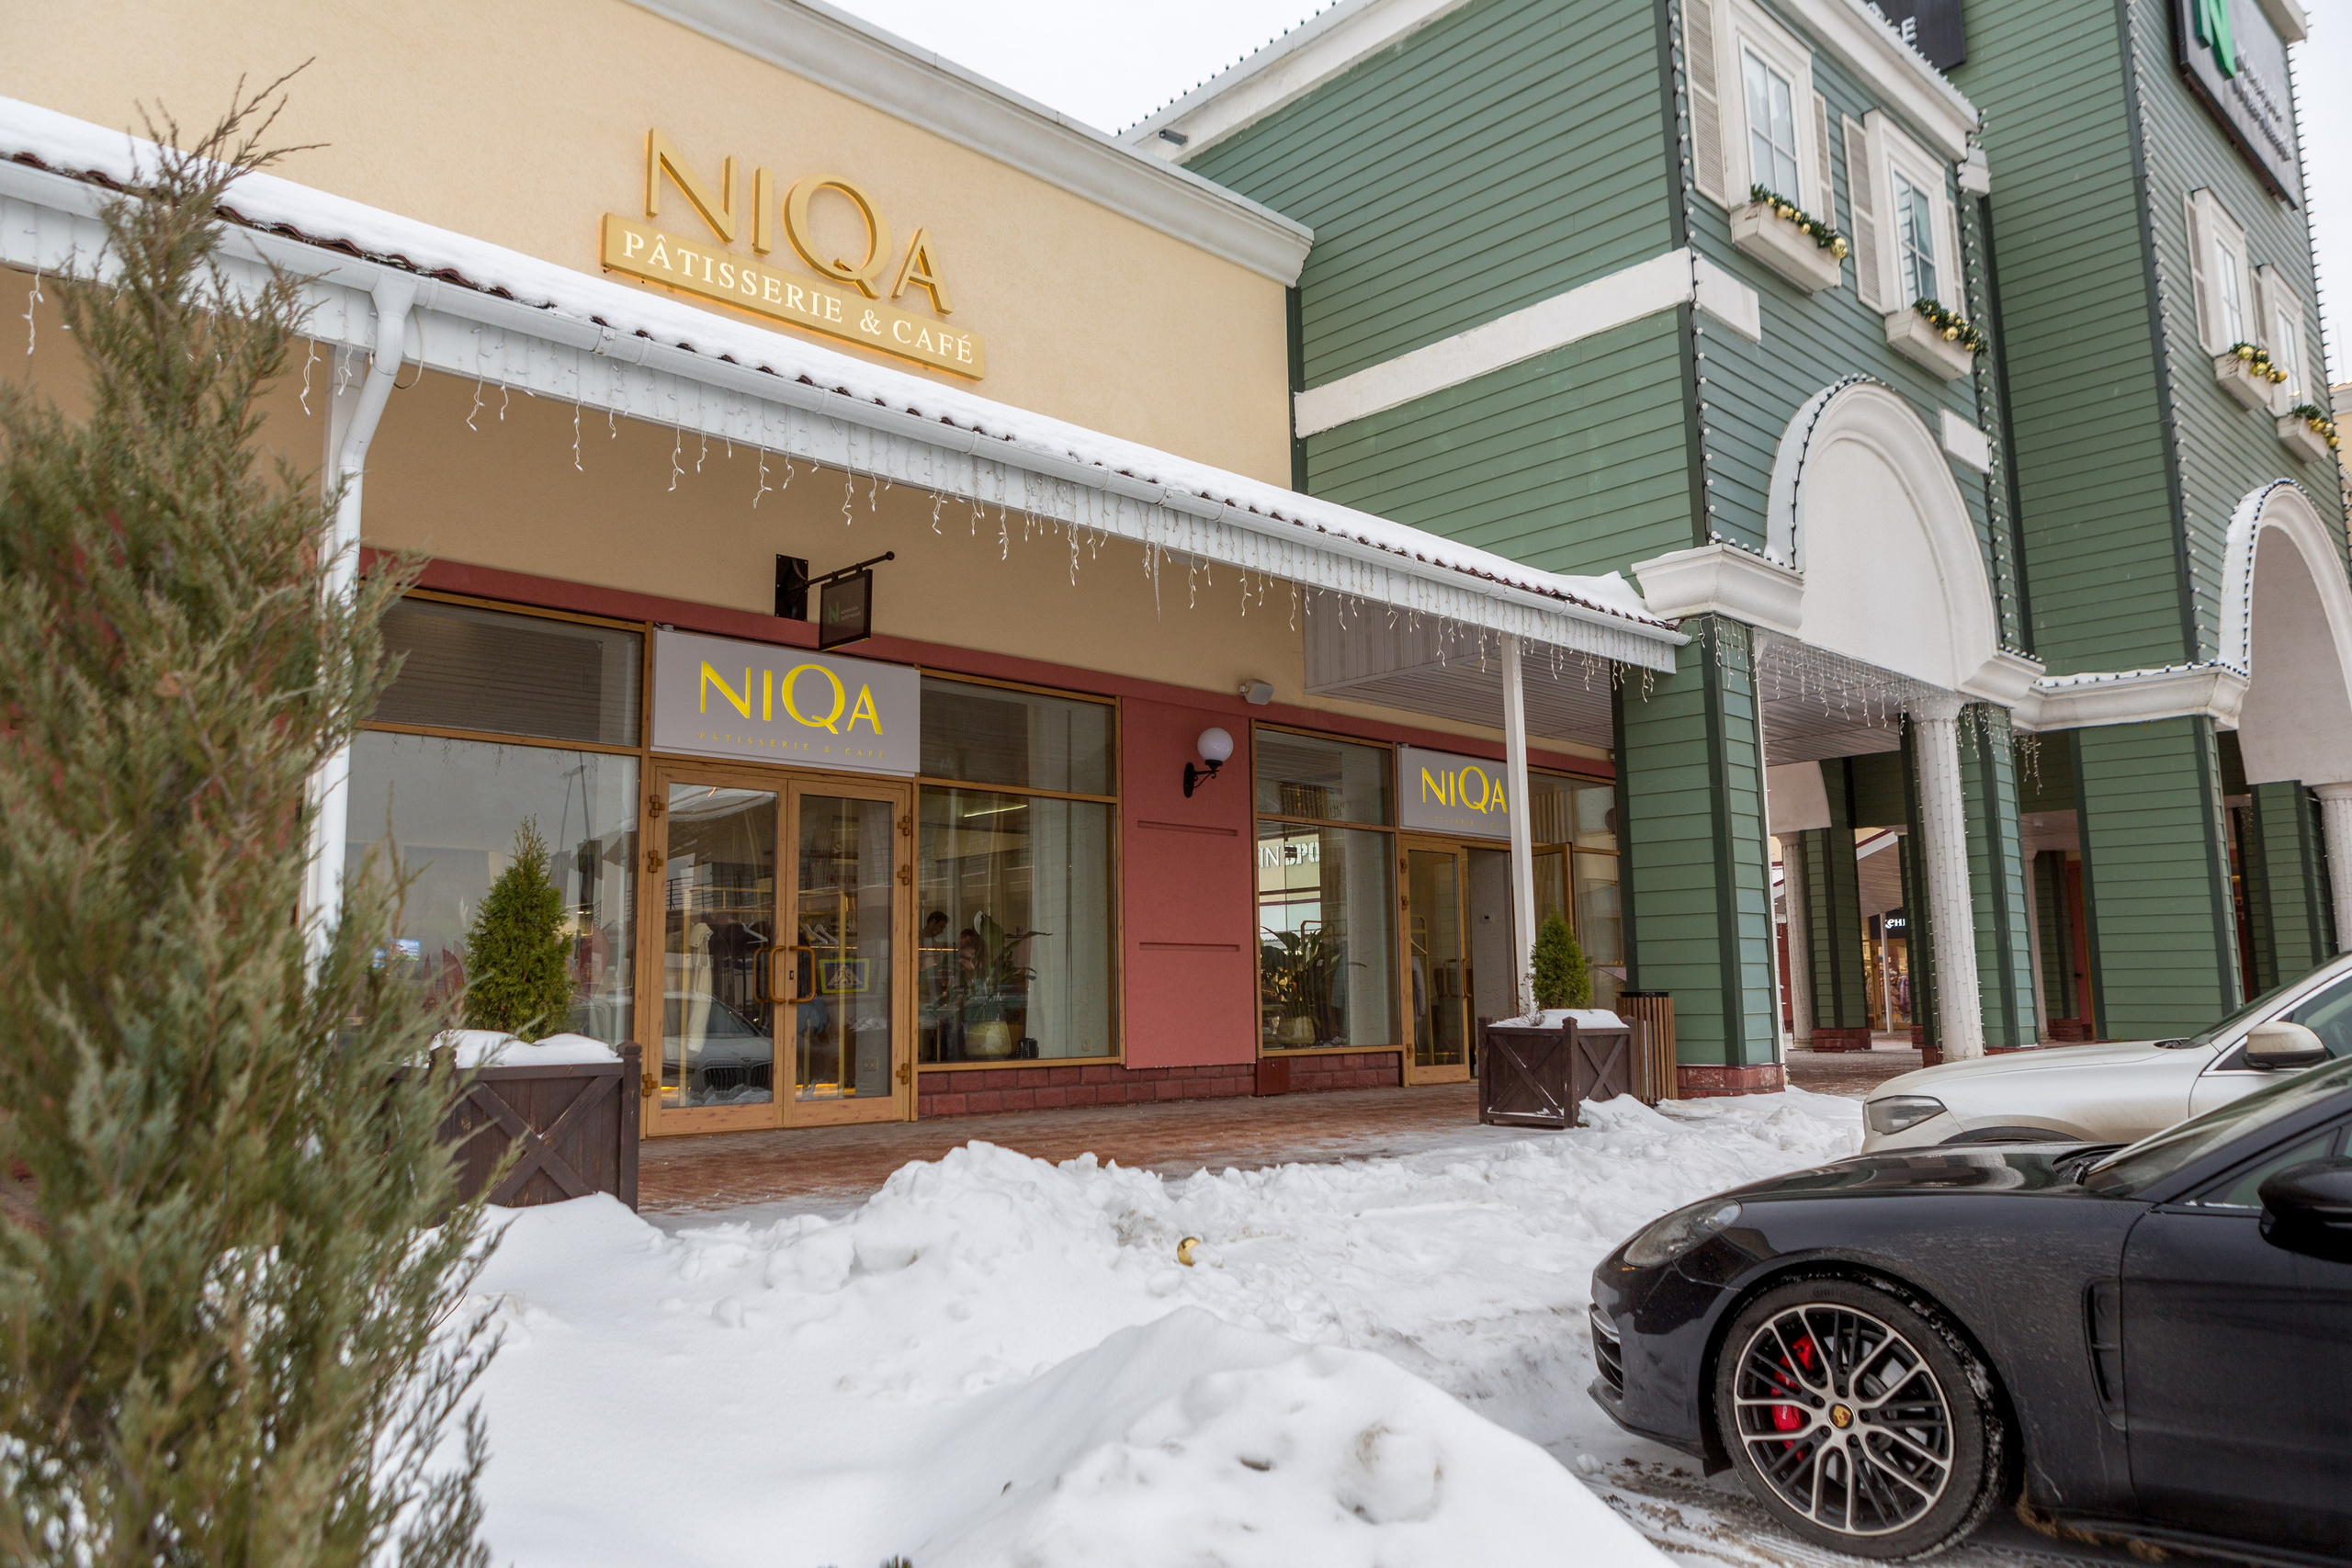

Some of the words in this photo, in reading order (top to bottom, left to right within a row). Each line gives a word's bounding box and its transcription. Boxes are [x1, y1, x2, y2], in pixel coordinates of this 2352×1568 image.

[645, 127, 954, 316] NIQA
[622, 230, 843, 324] PÂTISSERIE
[859, 309, 882, 335] &
[892, 318, 974, 365] CAFÉ
[700, 660, 884, 735] NIQA
[1421, 765, 1509, 815] NIQA
